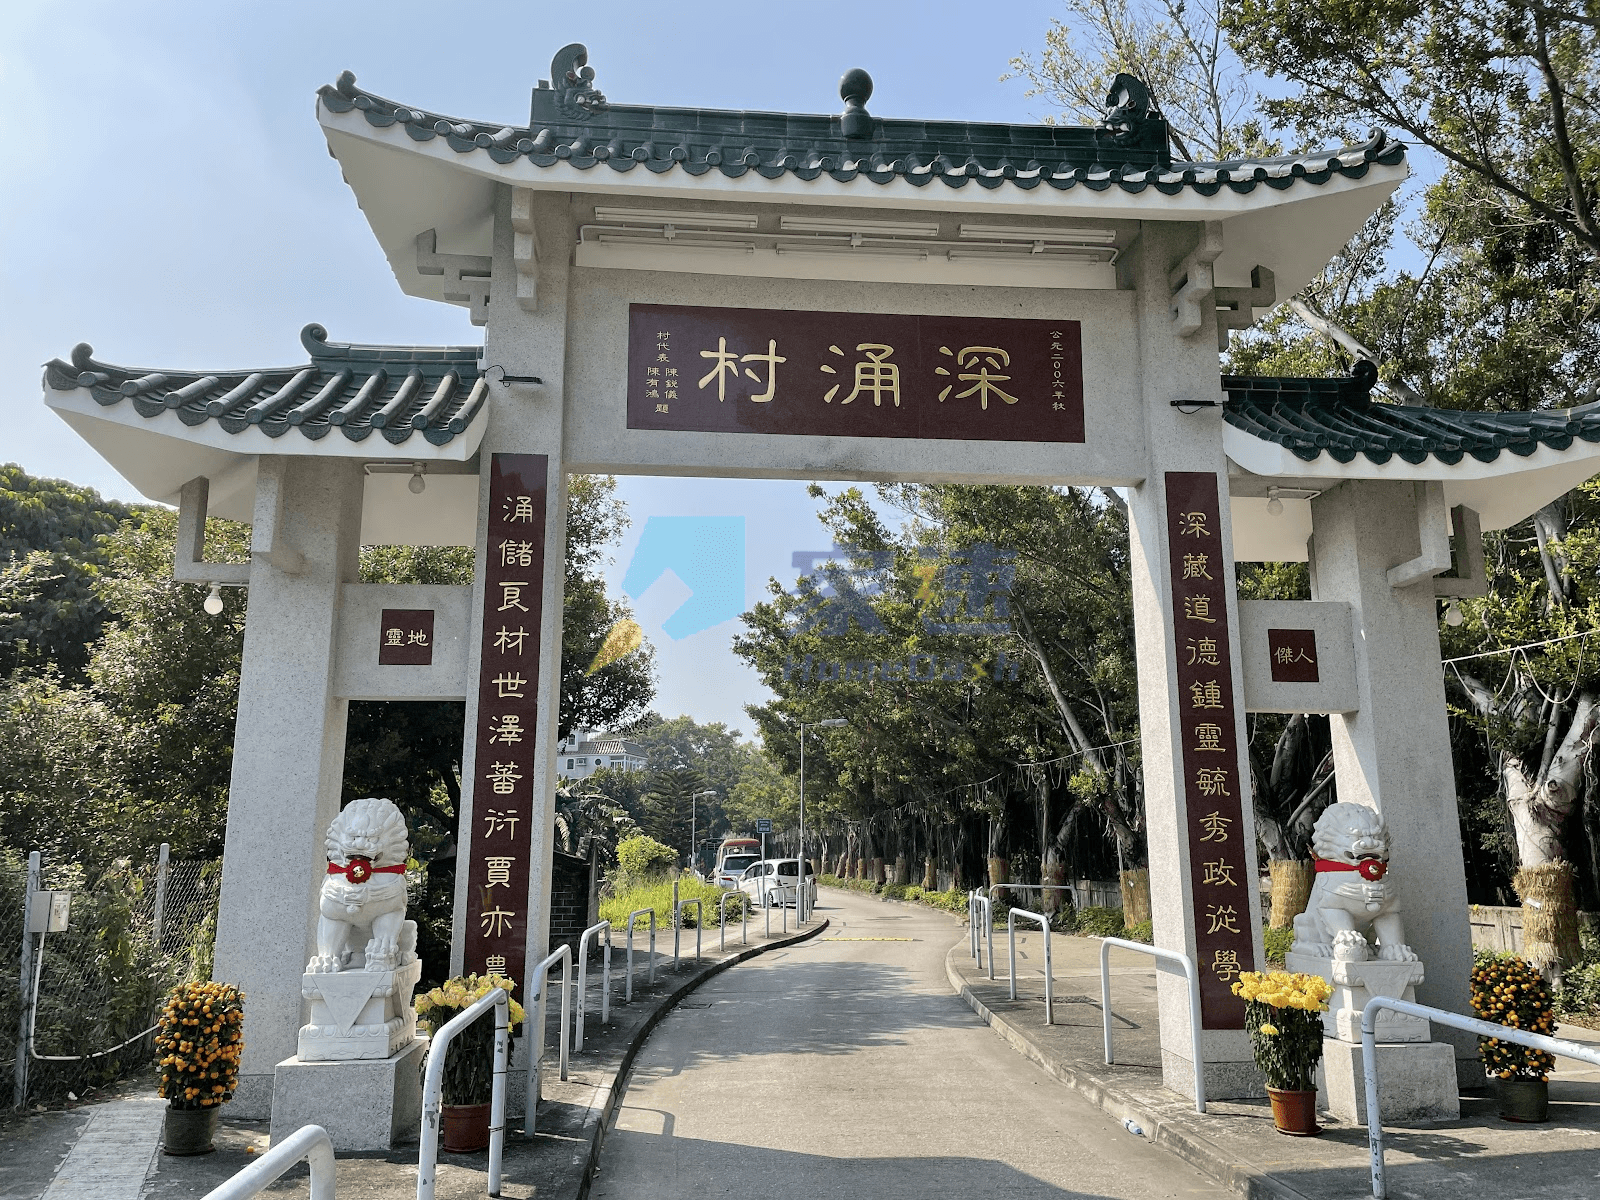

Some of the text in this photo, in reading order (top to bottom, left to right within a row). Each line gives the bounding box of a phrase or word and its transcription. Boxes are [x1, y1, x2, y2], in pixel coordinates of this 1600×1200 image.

[656, 331, 671, 363] 村代表
[646, 367, 660, 399] 陳有鴻
[698, 337, 1019, 411] 深涌村
